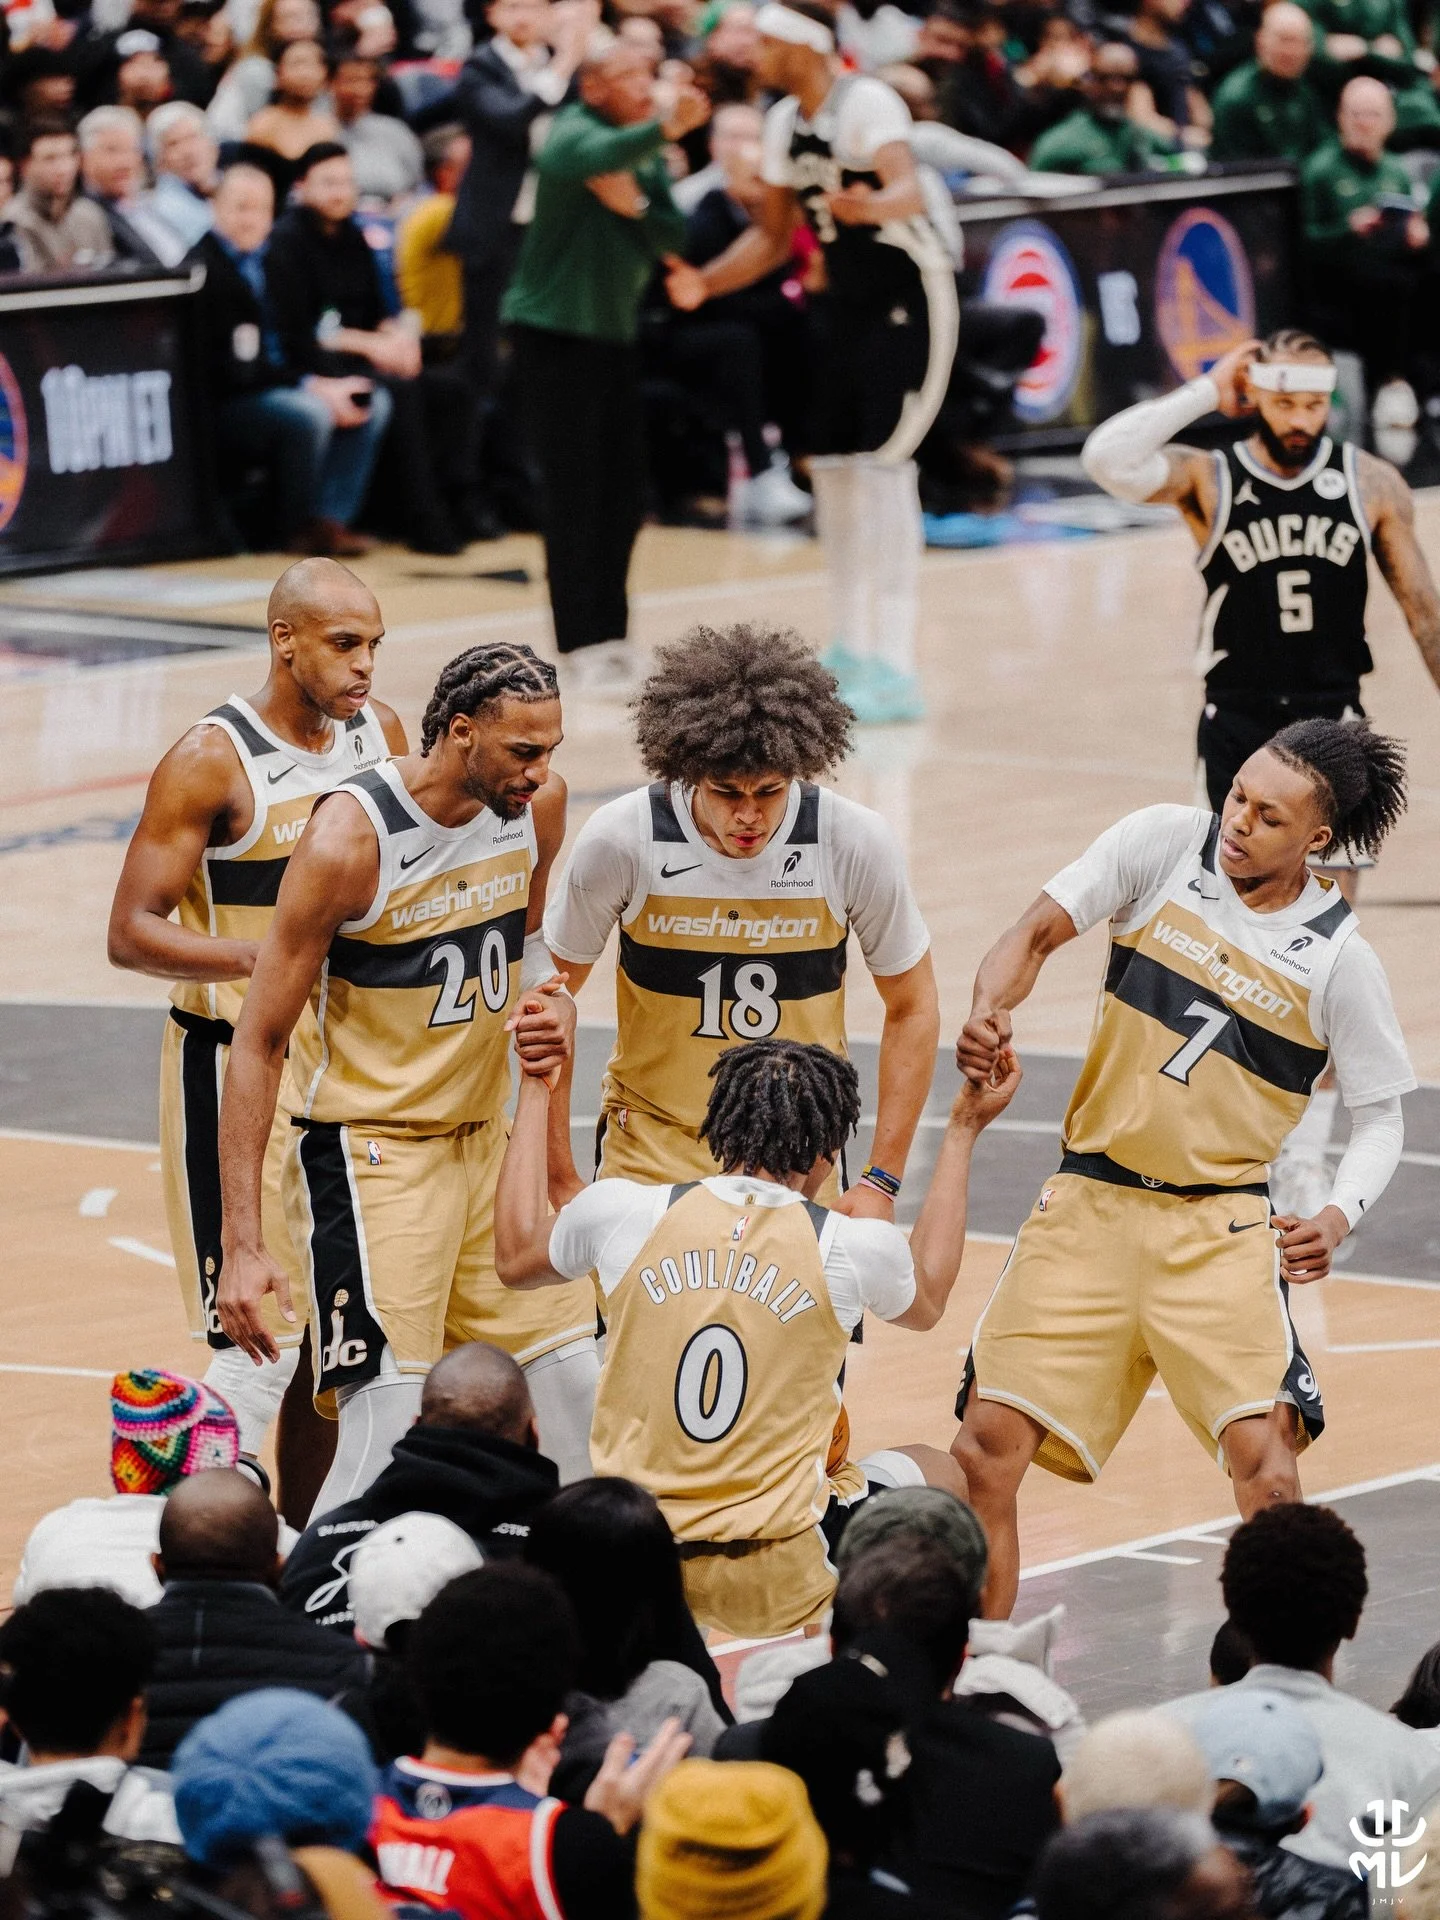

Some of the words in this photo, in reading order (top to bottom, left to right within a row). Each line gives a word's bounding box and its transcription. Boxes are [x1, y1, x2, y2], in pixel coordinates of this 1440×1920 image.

[1222, 514, 1360, 573] BUCKS
[1277, 570, 1314, 633] 5
[353, 756, 382, 771] Robinhood
[492, 829, 524, 845] Robinhood
[391, 871, 526, 930] washington
[770, 879, 815, 889] Robinhood
[648, 906, 819, 947] washington
[427, 925, 510, 1029] 20
[1152, 920, 1294, 1020] washington
[1270, 948, 1312, 975] Robinhood
[691, 958, 781, 1041] 18
[1159, 997, 1232, 1086] 7
[639, 1248, 818, 1325] COULIBALY
[674, 1323, 749, 1444] 0
[377, 1841, 456, 1896] WALL
